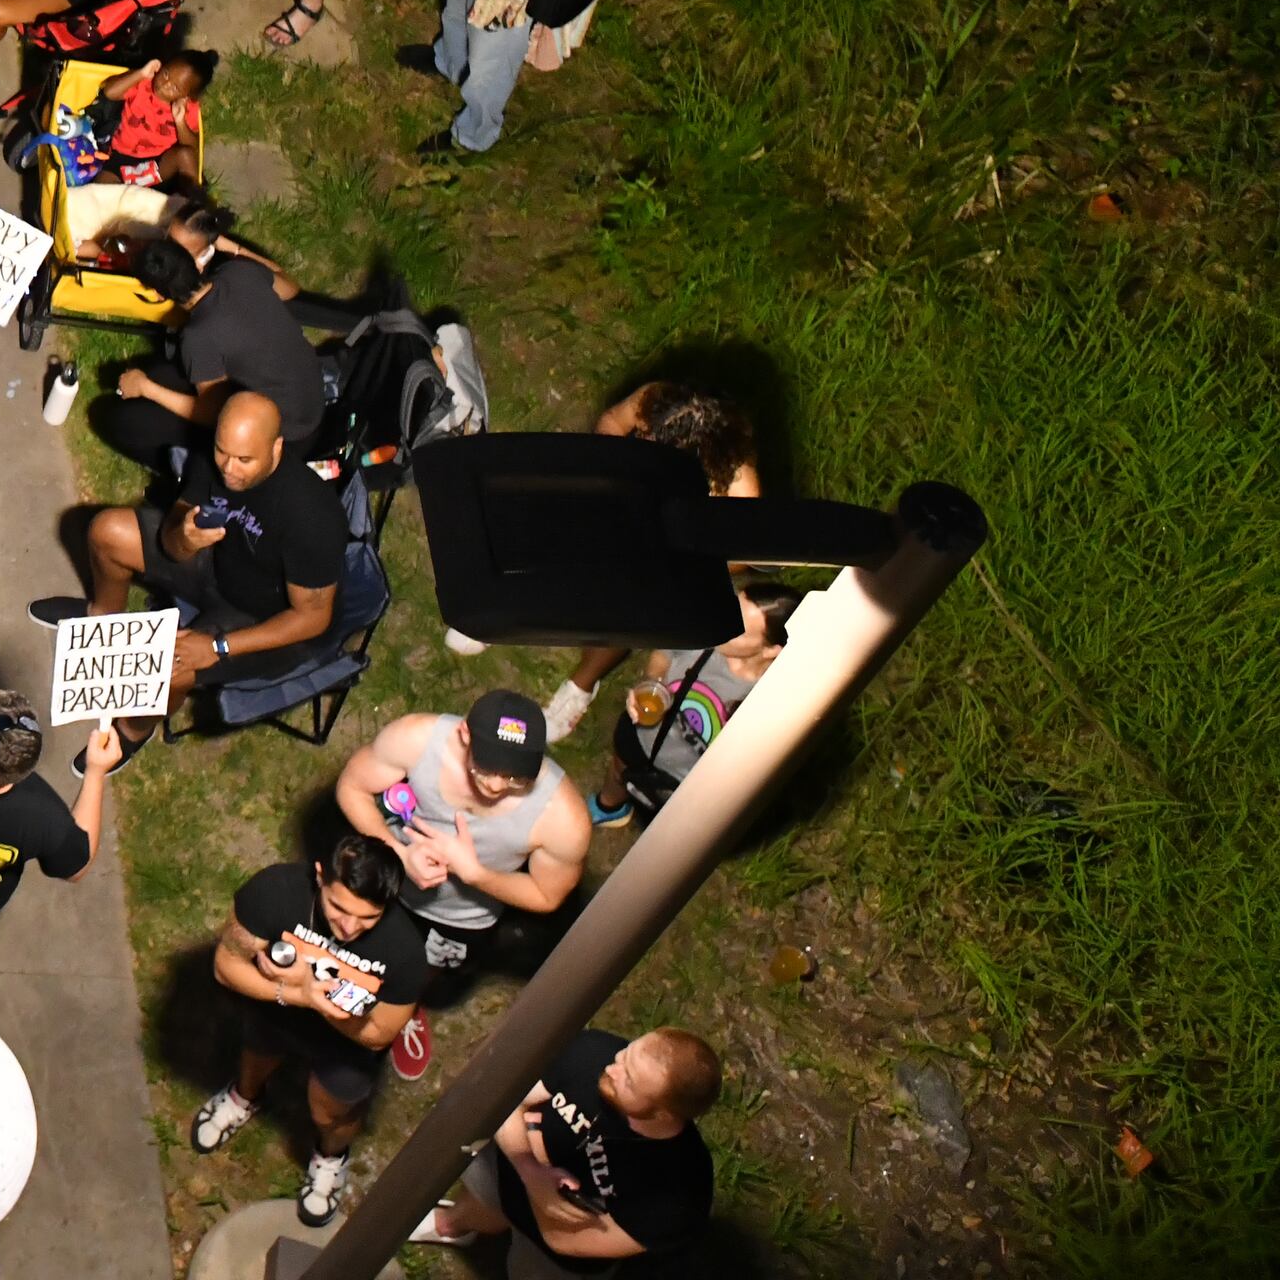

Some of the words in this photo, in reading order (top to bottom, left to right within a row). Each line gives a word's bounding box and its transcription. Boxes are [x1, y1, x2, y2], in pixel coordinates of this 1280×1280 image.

[68, 617, 164, 651] HAPPY
[63, 650, 164, 682] LANTERN
[60, 681, 165, 713] PARADE!
[293, 923, 372, 974] NINTENDO
[551, 1091, 592, 1134] OAT
